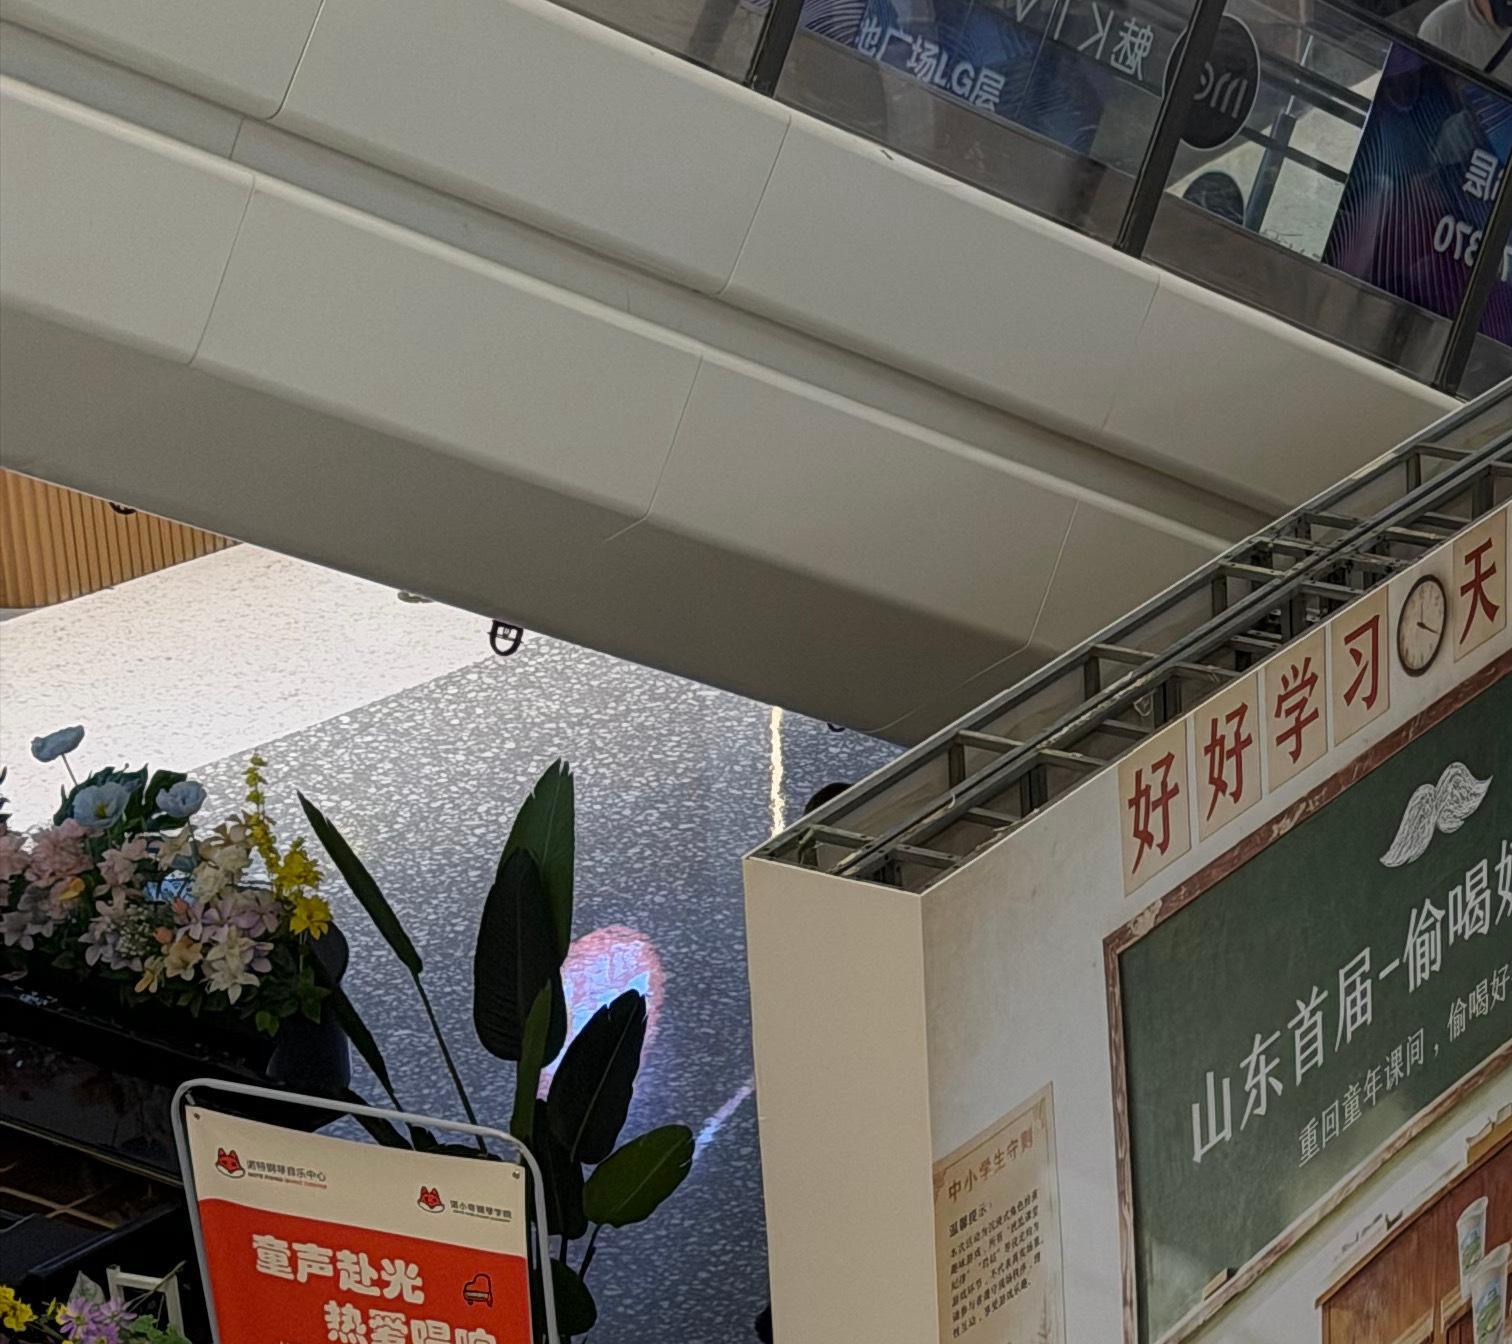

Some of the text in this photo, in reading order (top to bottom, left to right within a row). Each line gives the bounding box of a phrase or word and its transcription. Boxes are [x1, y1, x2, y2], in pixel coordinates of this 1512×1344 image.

[1127, 614, 1381, 876] 好好学习
[947, 1126, 1034, 1204] 中小学生守则
[252, 1234, 425, 1306] 童声赴光
